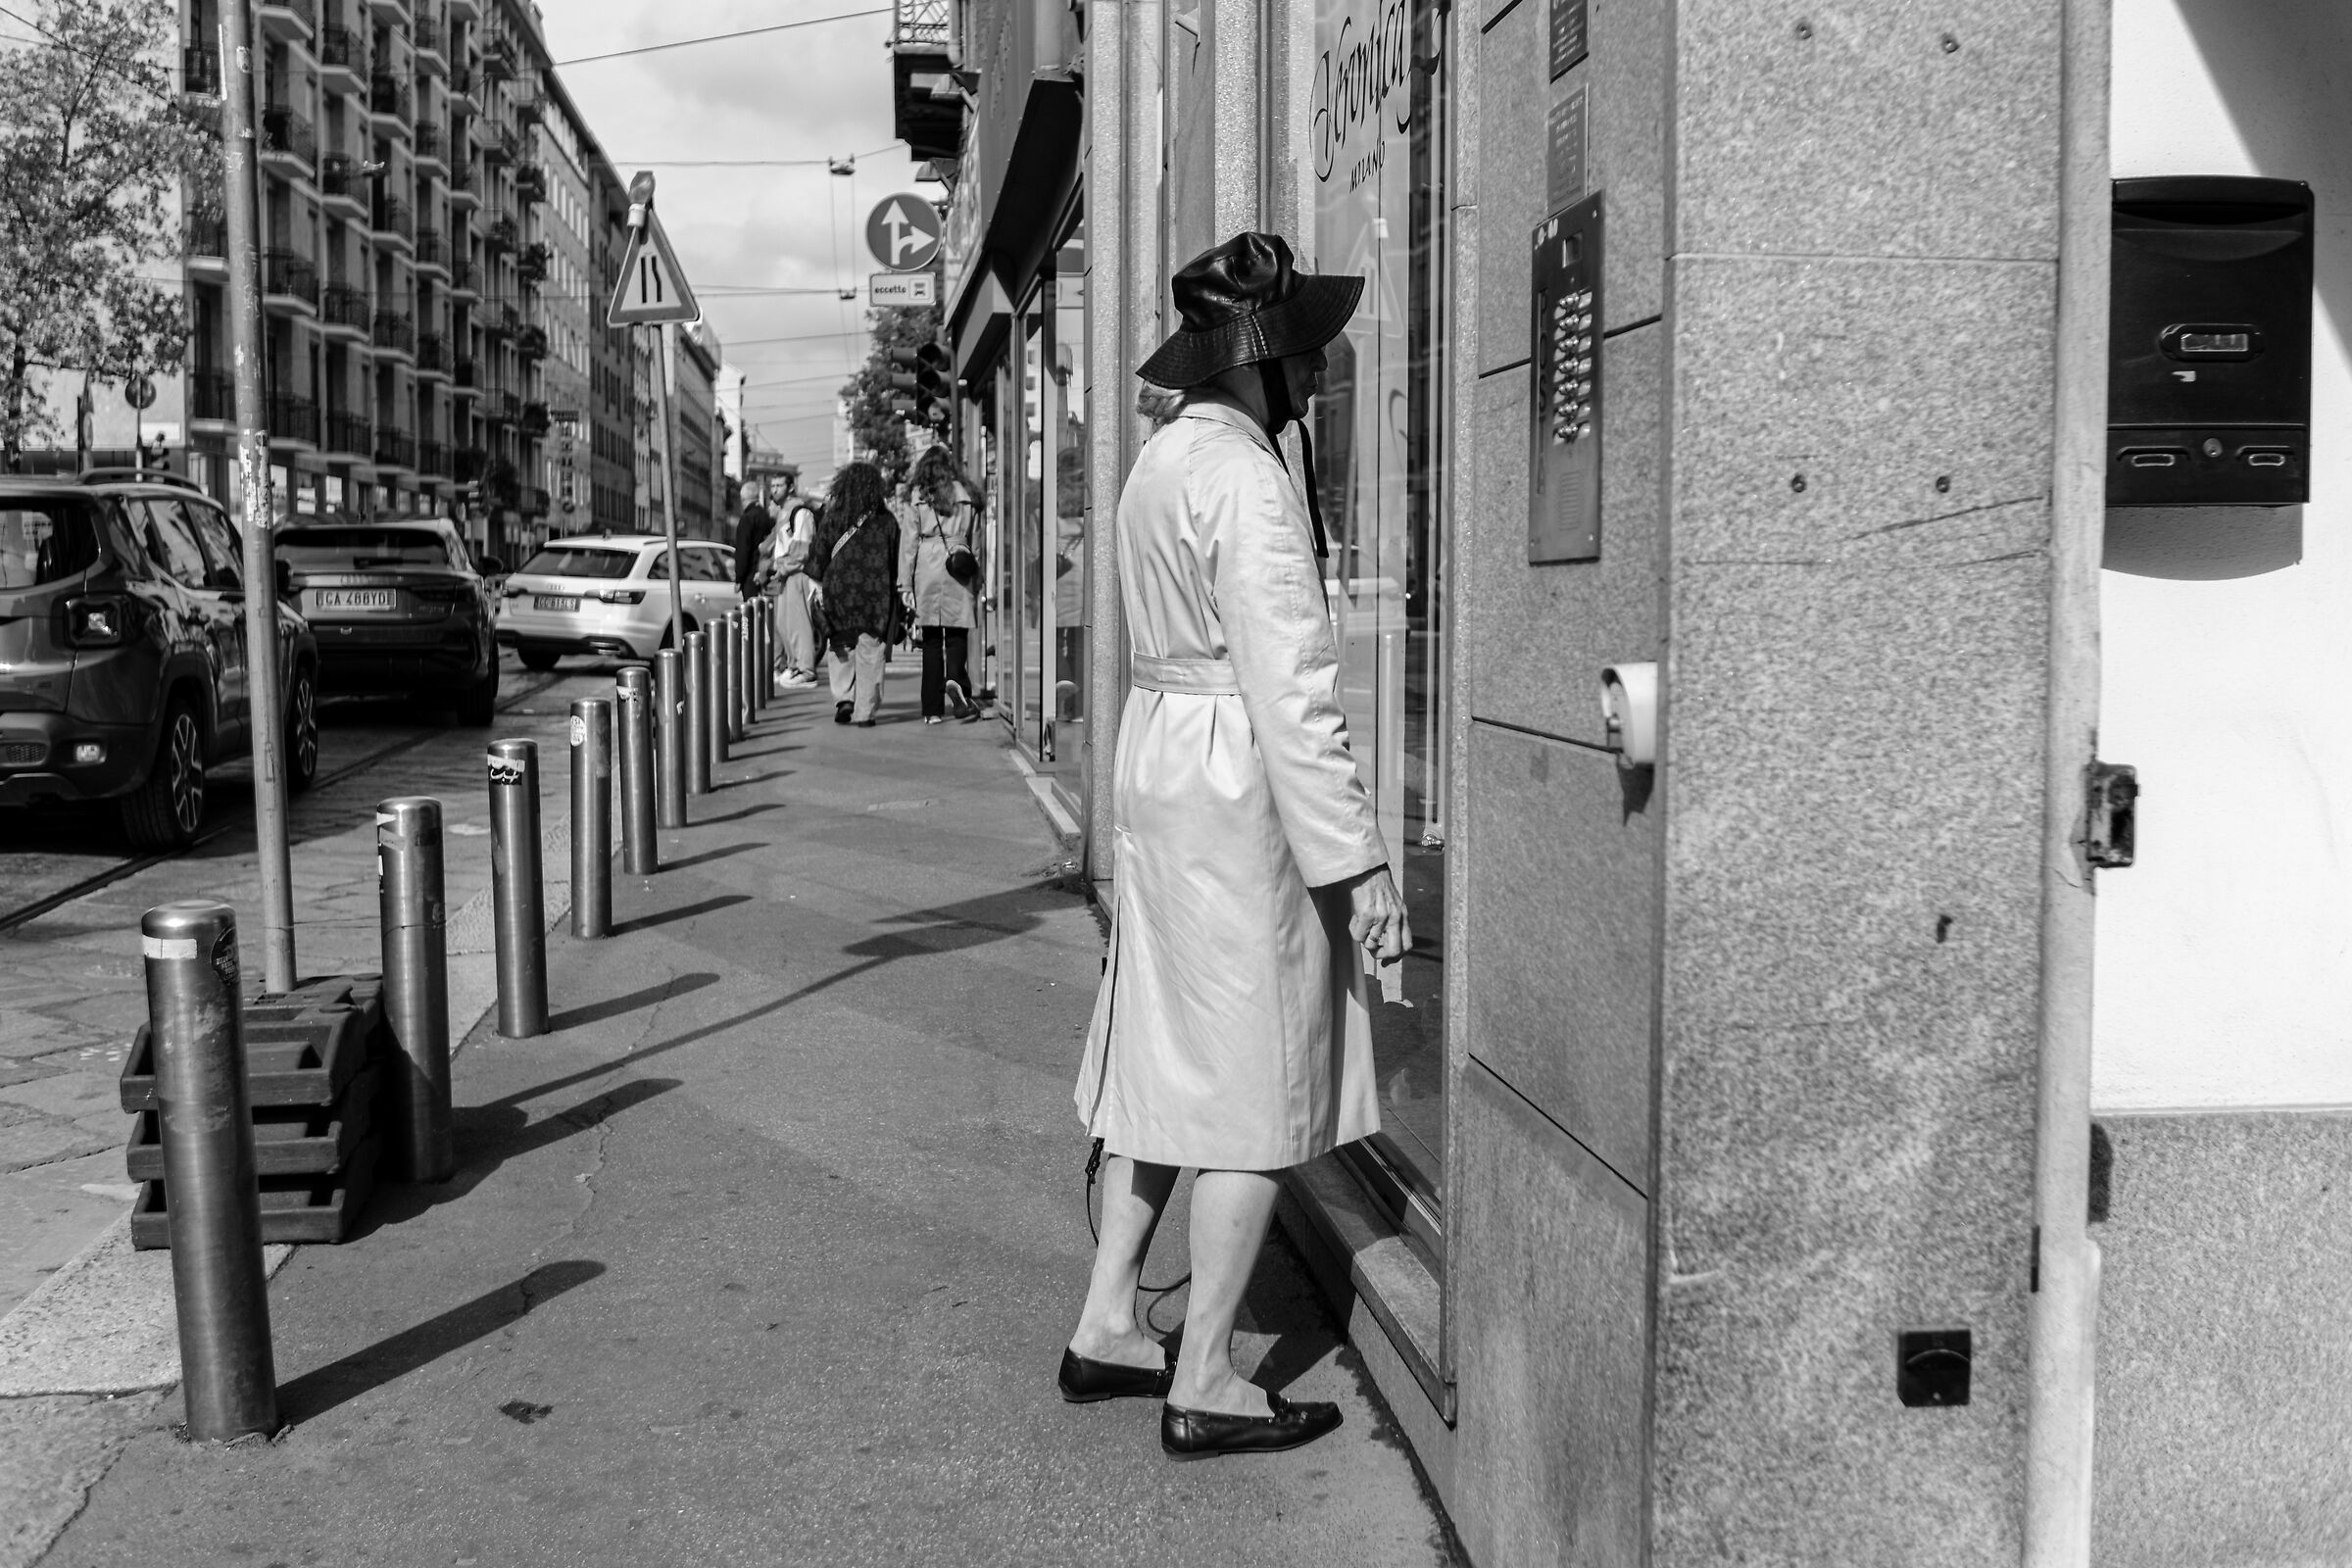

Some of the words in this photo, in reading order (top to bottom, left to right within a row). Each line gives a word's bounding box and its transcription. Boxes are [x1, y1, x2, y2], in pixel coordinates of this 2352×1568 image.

[1309, 0, 1412, 183] Veronica
[1349, 135, 1386, 193] MILANO
[874, 284, 906, 294] eccetto
